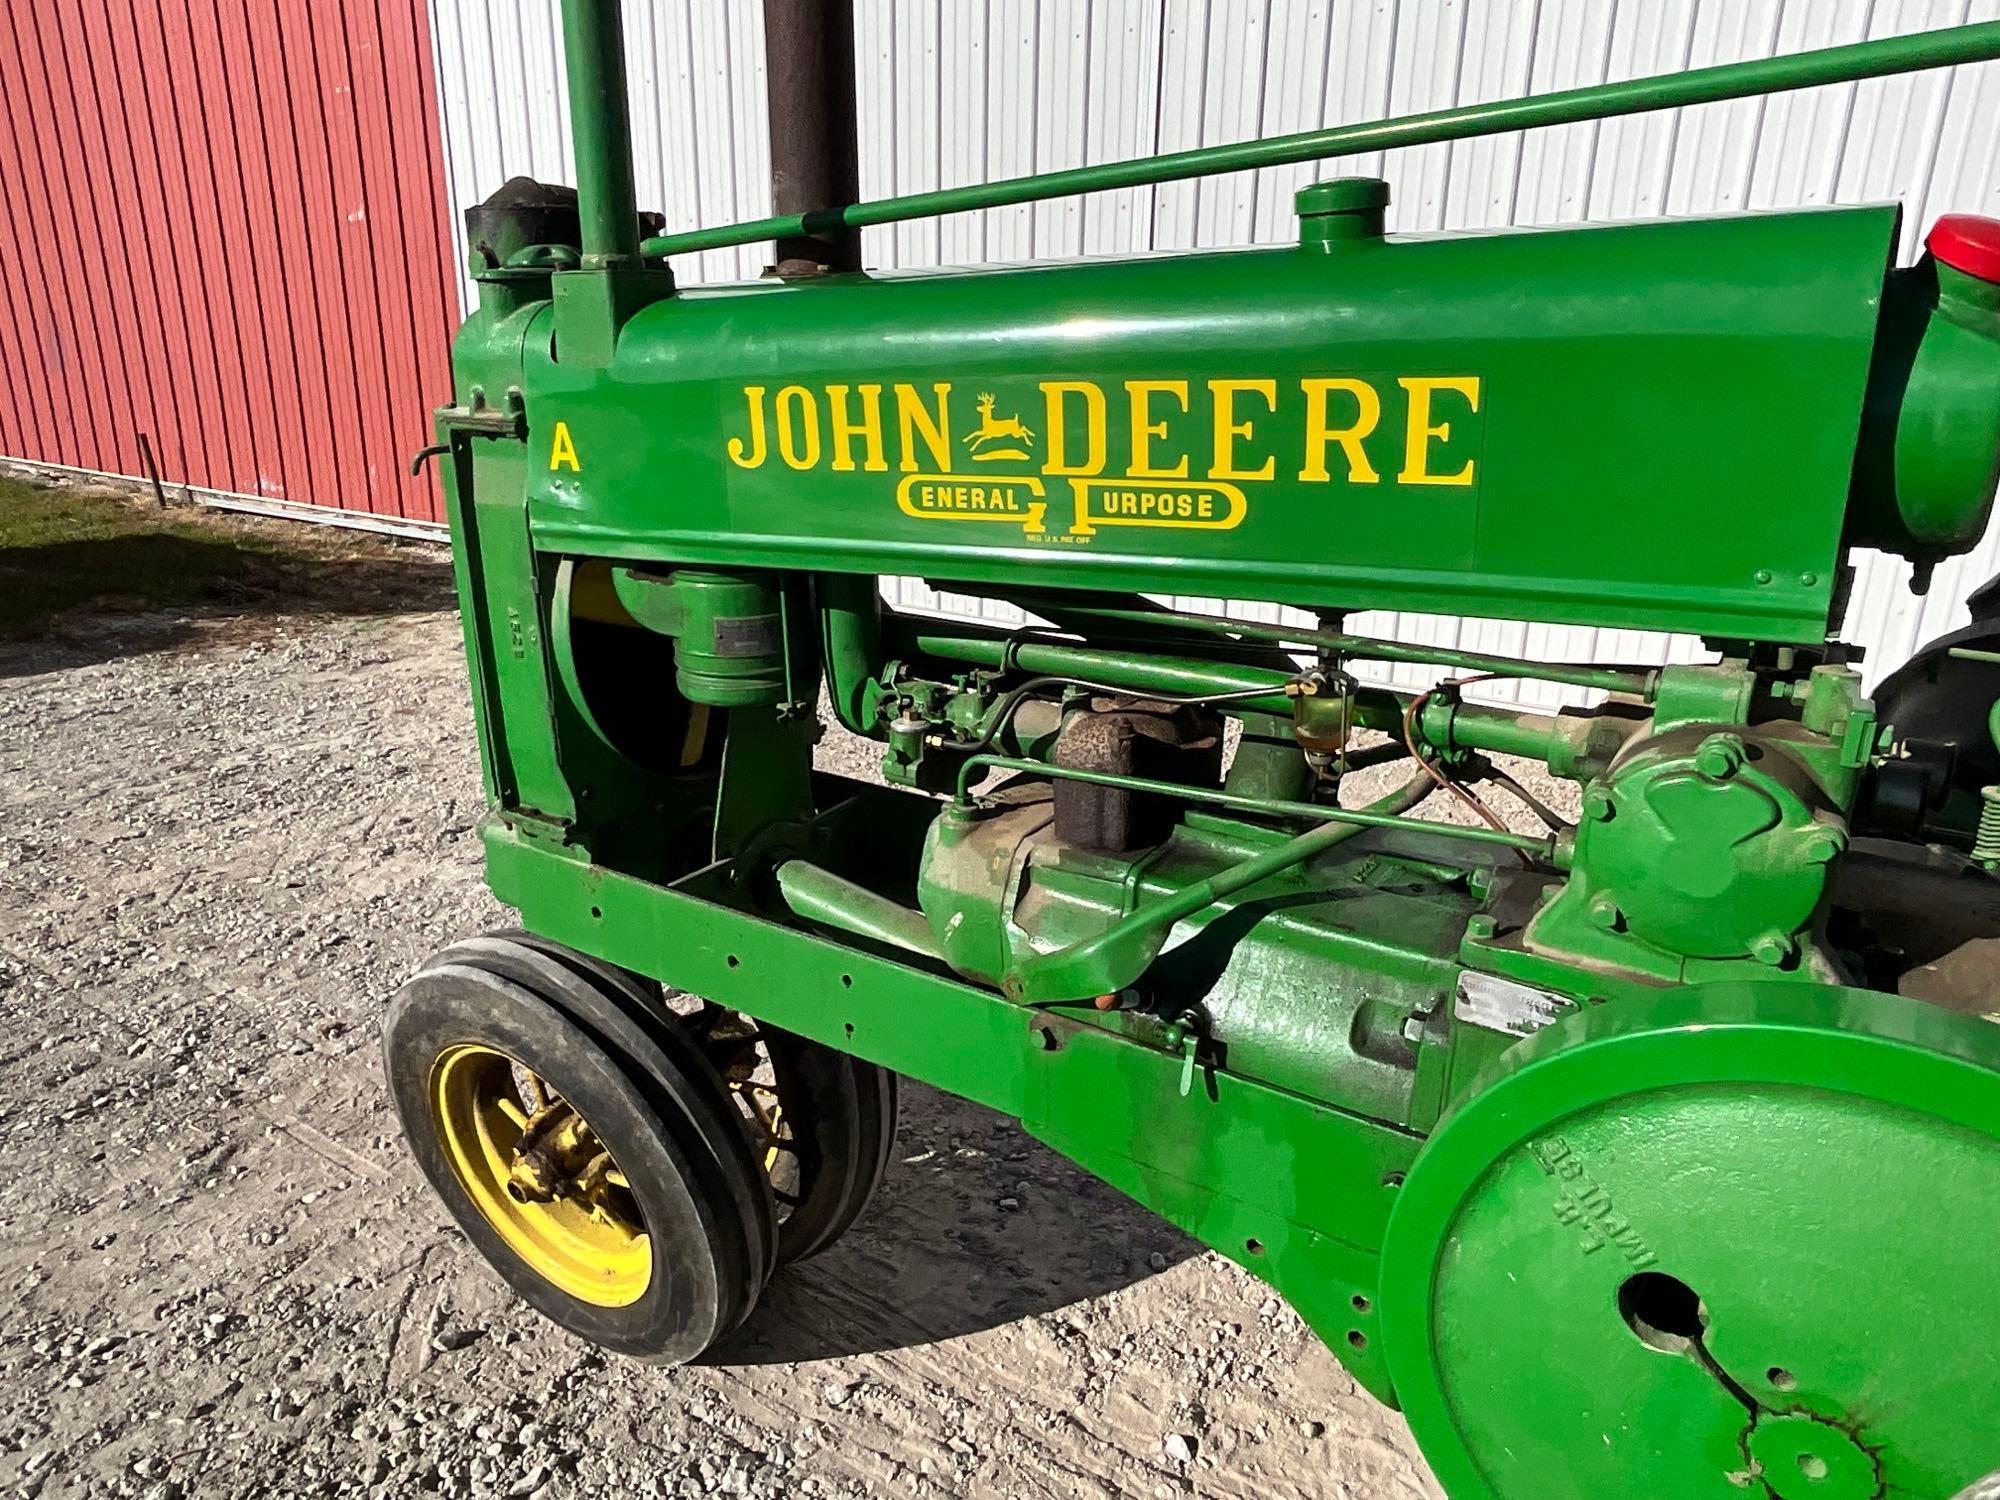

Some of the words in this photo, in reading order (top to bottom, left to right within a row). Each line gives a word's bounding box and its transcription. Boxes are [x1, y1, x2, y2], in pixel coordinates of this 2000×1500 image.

[550, 422, 580, 472] A
[727, 383, 951, 472] JOHN
[1039, 376, 1479, 486] DEERE
